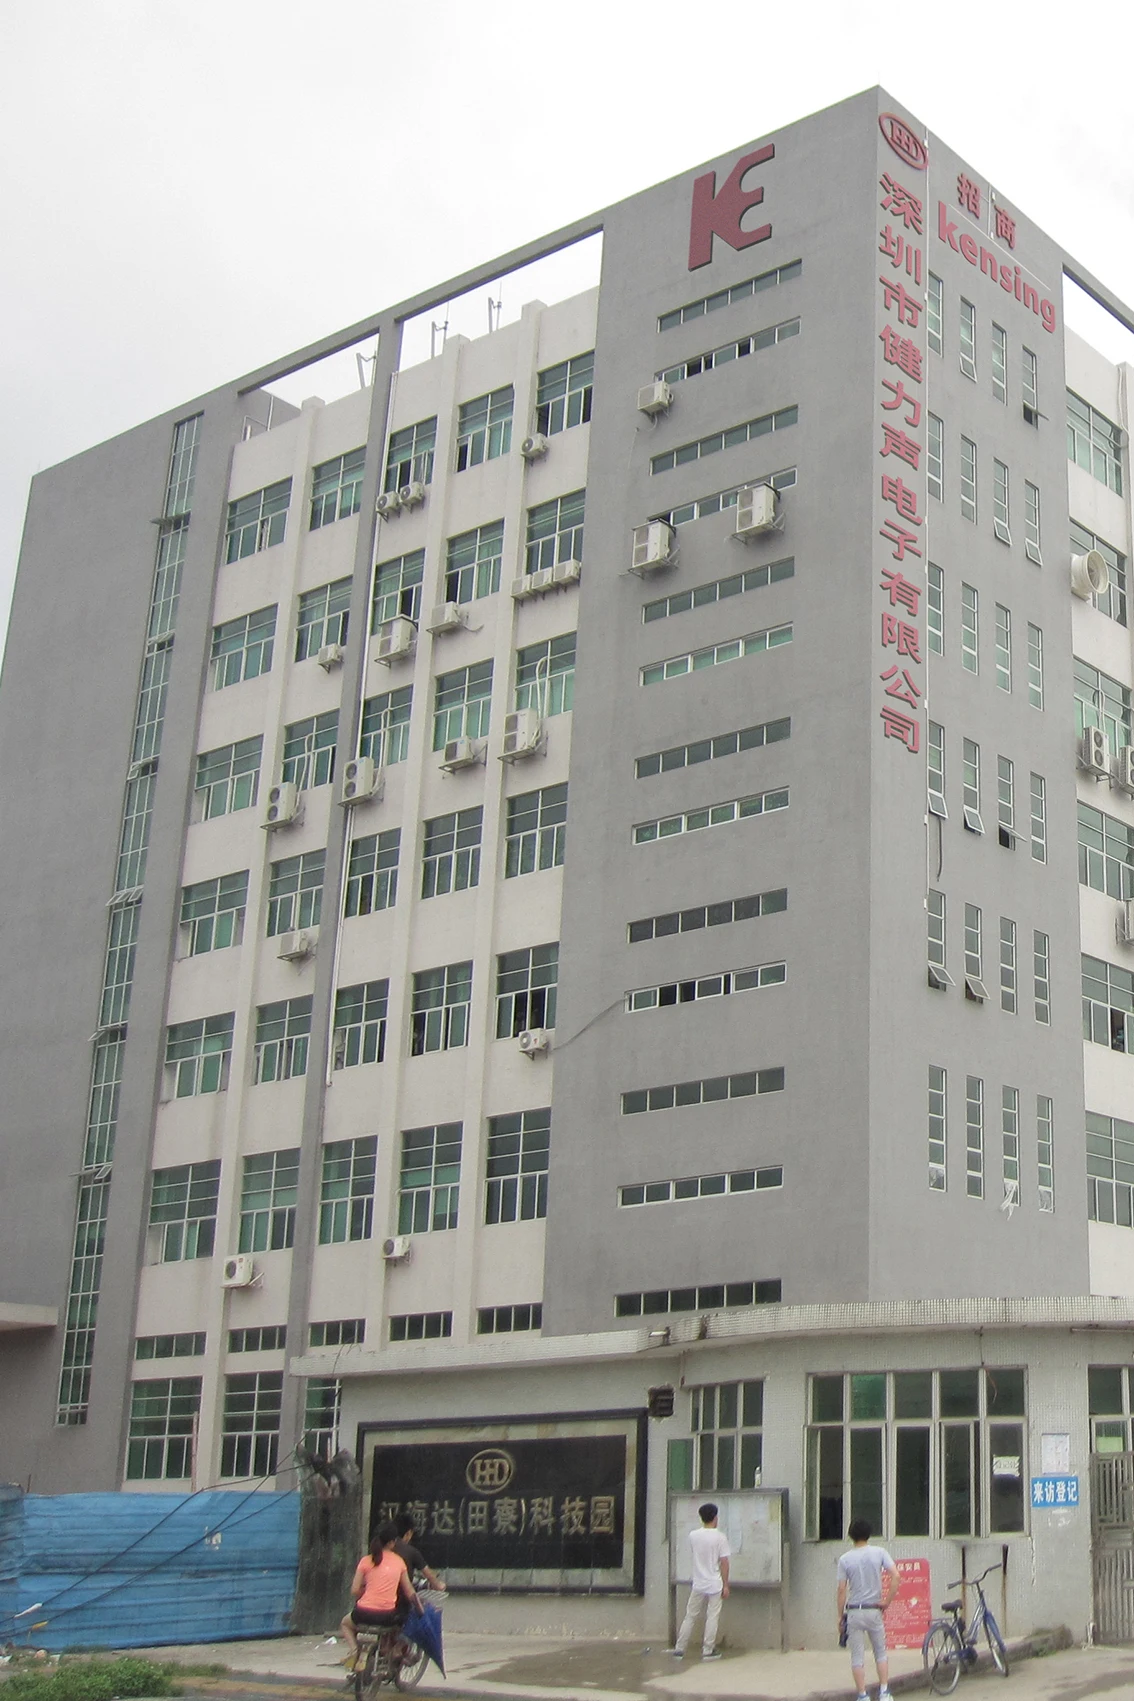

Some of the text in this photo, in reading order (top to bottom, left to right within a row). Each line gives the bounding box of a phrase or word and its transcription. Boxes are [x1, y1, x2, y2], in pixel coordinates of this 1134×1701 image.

[957, 172, 1016, 249] 招商
[938, 200, 1056, 333] kensing
[878, 171, 924, 754] 深圳市健力声电子有限公司
[1033, 1481, 1078, 1503] 来访登记
